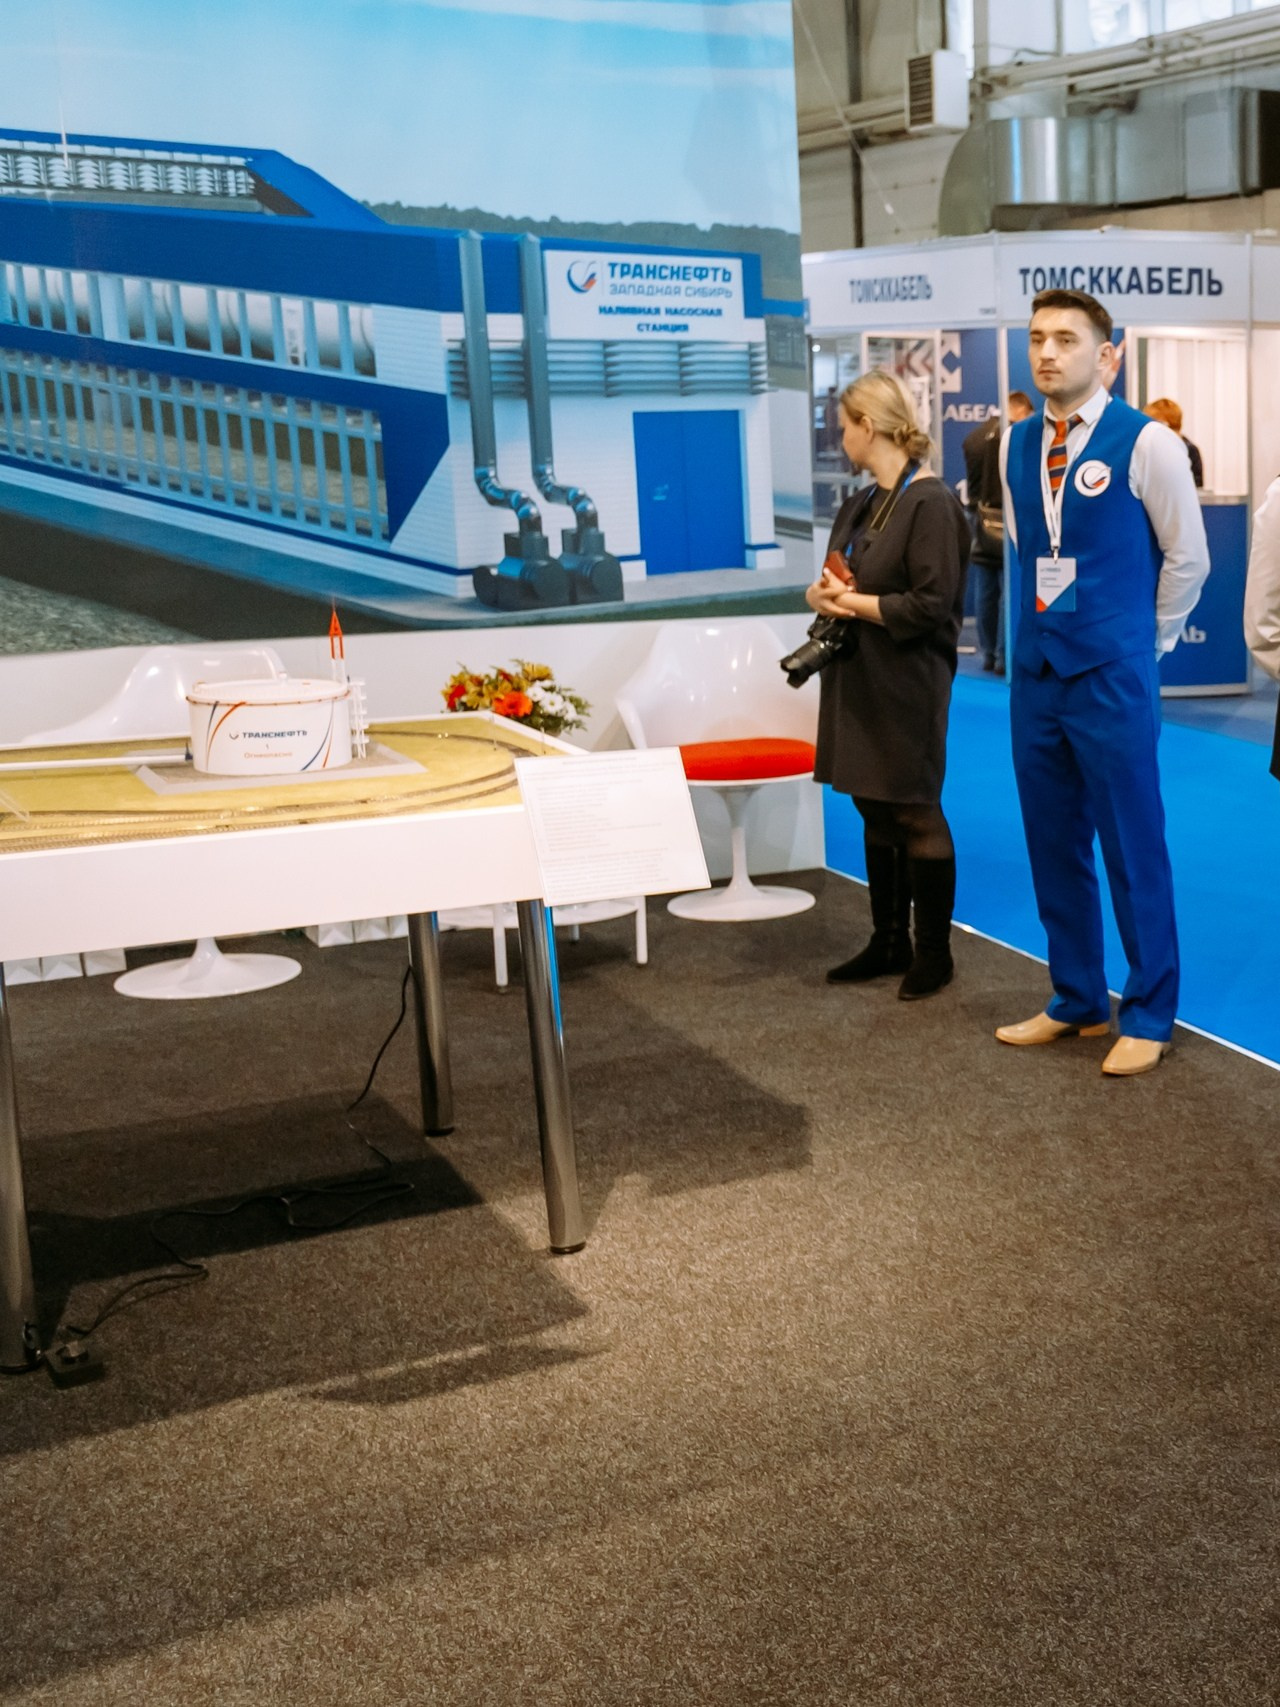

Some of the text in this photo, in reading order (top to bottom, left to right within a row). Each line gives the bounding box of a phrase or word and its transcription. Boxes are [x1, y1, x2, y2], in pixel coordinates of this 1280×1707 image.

[607, 262, 732, 283] ТРАНСНЕФТЬ
[849, 274, 933, 303] ТОМСККАБЕЛЬ
[1019, 266, 1223, 297] ТОМСККАБЕЛЬ
[609, 283, 733, 298] ЗАПАДНАЯ СИБИРЬ
[599, 305, 722, 317] НАЛИВНАЯ НАСОСНАЯ
[636, 323, 689, 333] СТАНЦИЯ
[242, 730, 308, 739] ТРАНСНЕФТЬ
